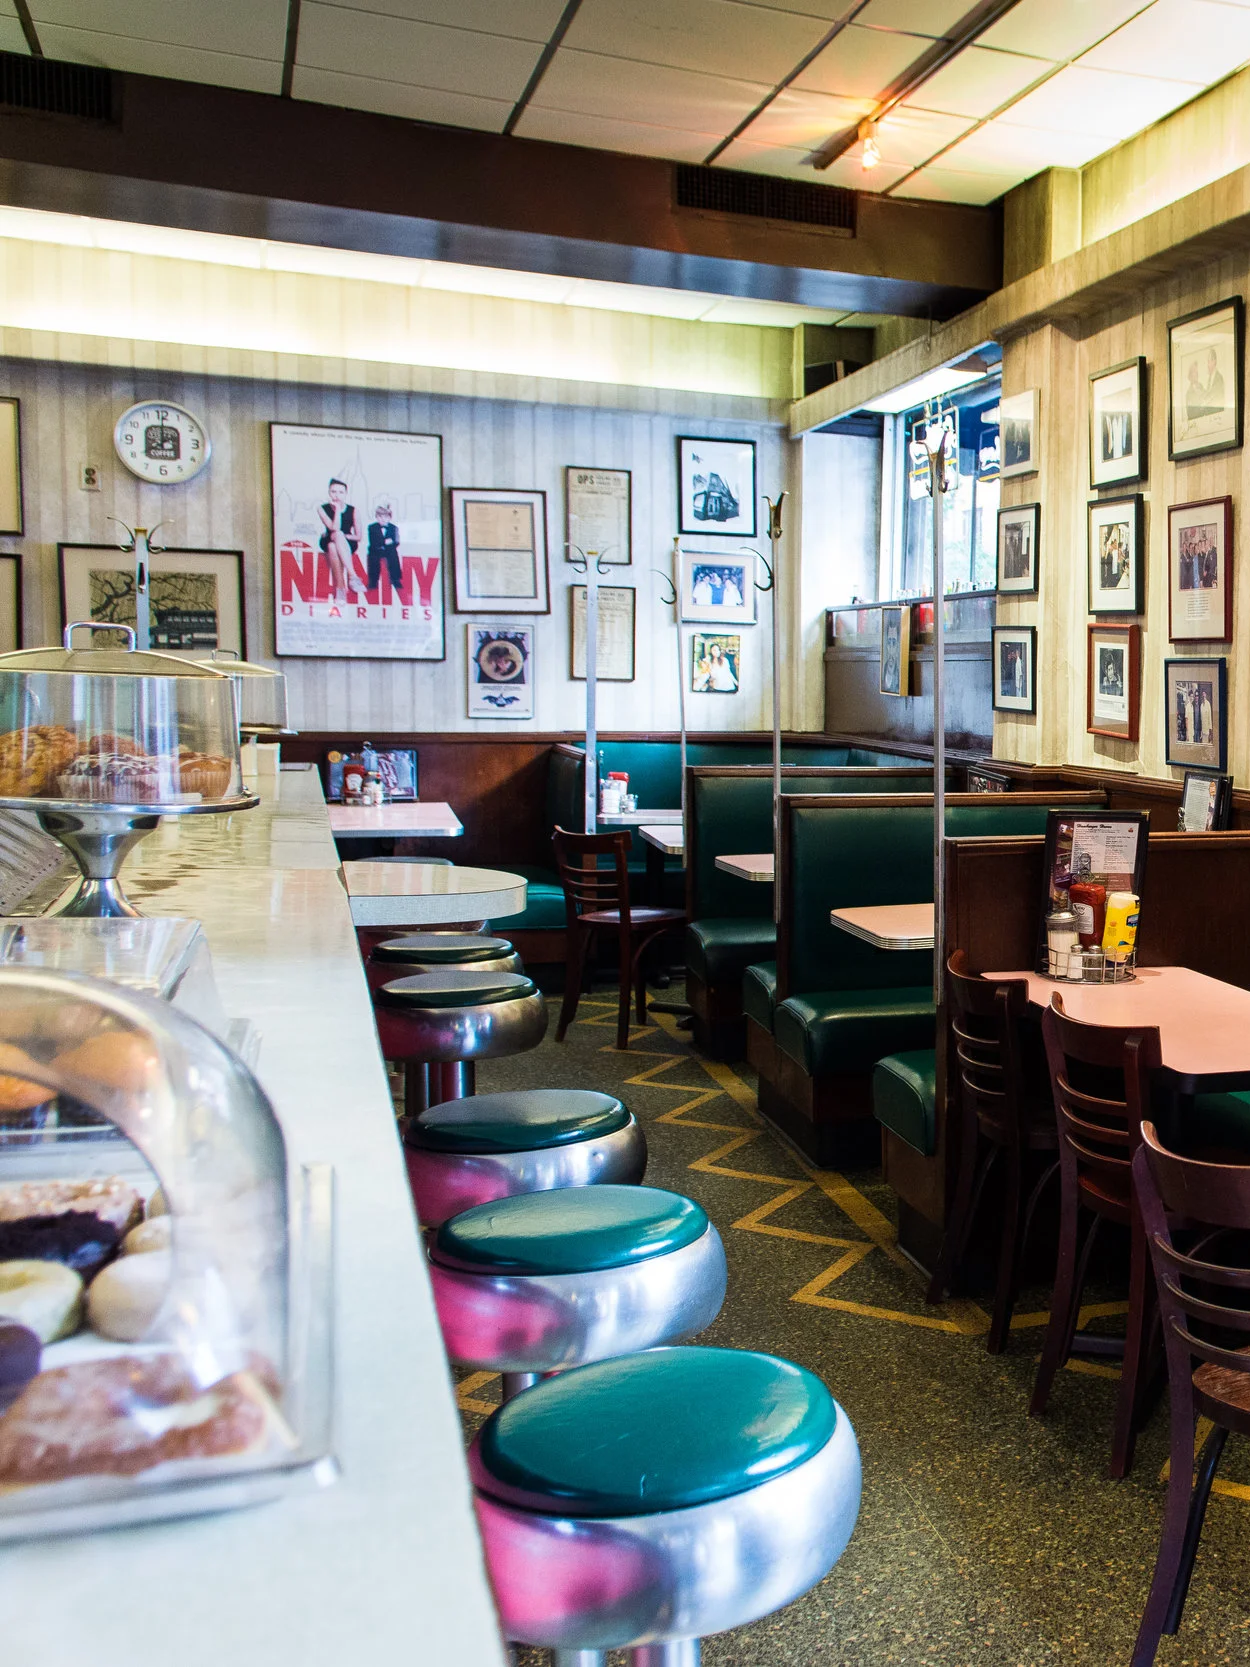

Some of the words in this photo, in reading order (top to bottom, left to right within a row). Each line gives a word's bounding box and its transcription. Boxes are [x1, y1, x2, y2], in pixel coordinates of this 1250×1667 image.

[155, 409, 169, 421] 12
[125, 434, 133, 445] 9
[192, 439, 199, 450] 3
[160, 465, 168, 475] 6
[280, 550, 440, 607] NANNY
[281, 604, 433, 621] DIARIES
